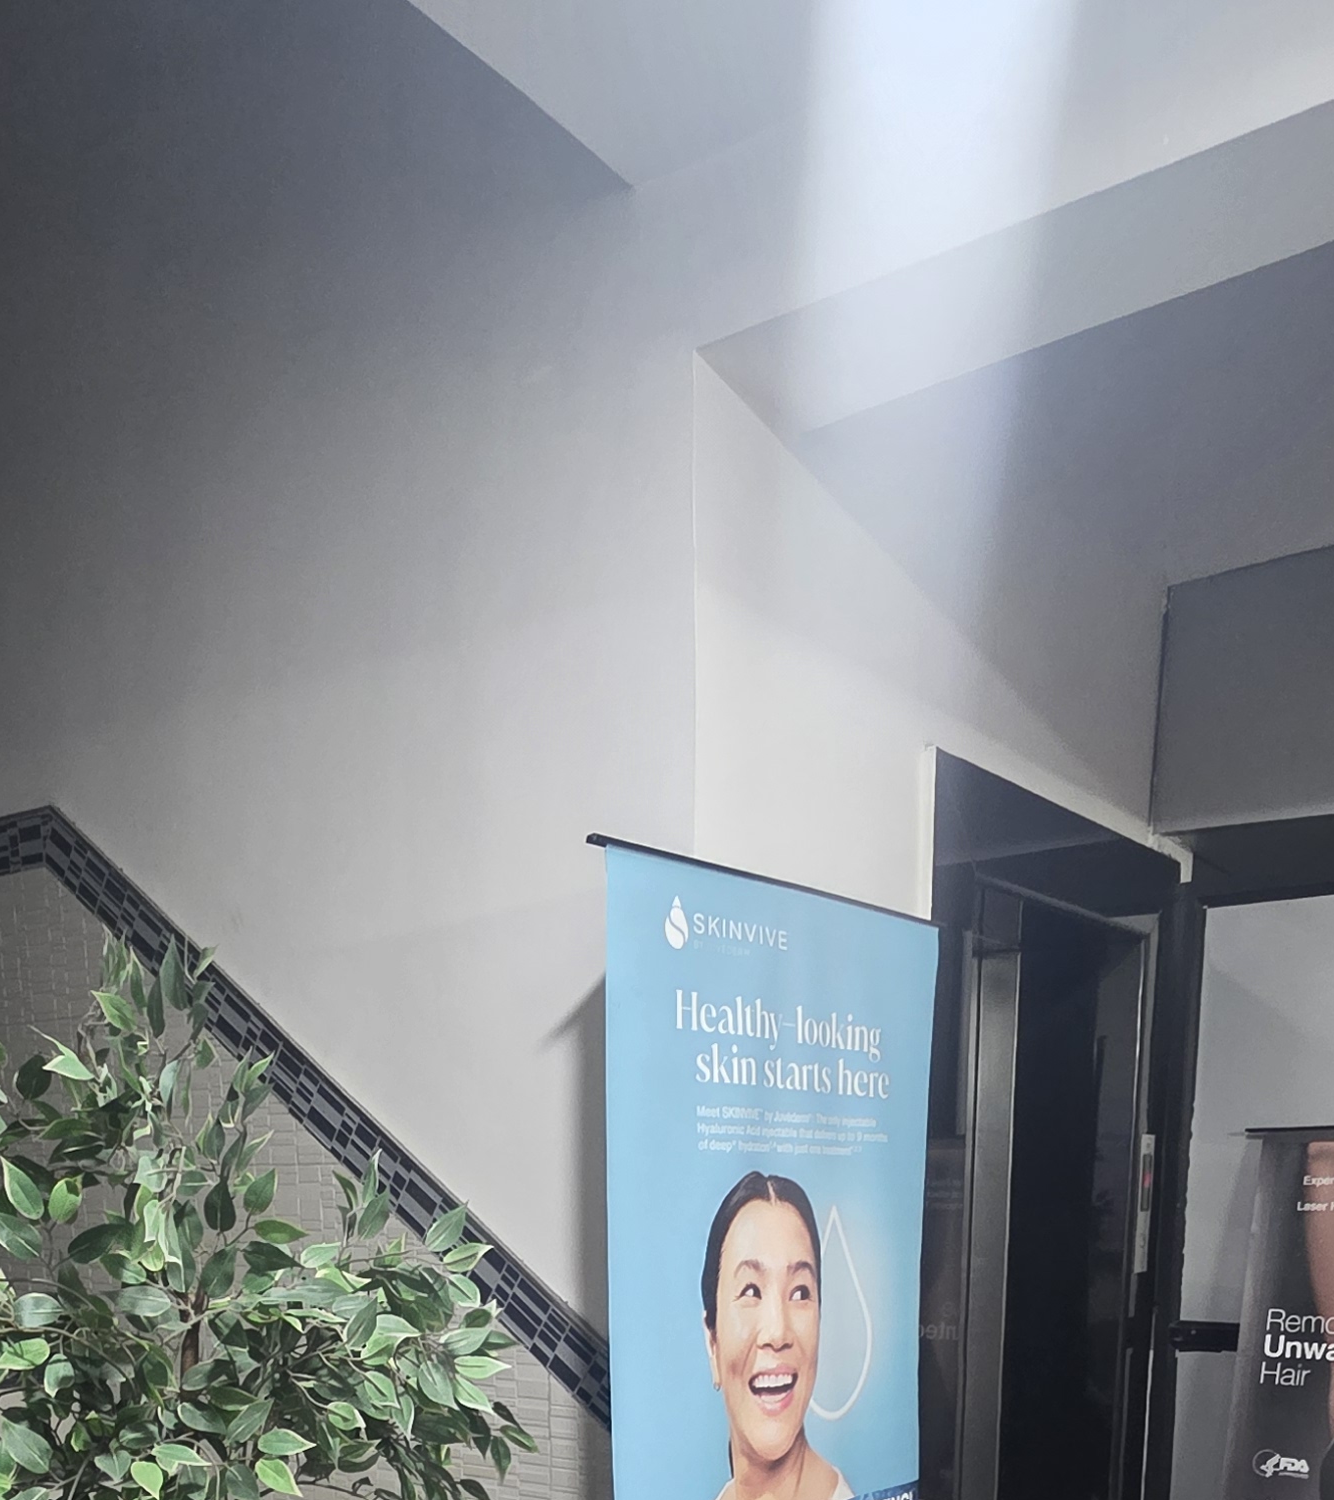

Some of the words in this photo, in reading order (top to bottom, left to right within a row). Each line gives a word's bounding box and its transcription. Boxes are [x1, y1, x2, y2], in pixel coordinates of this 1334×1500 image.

[693, 912, 789, 951] SKINVIVE
[675, 989, 882, 1063] Healthy-looking
[695, 1043, 757, 1086] skin
[763, 1057, 831, 1094] starts
[837, 1058, 889, 1099] here
[697, 1122, 745, 1137] Hyaluronic
[1296, 1201, 1327, 1212] Laser
[1259, 1361, 1312, 1387] Hair
[1279, 1457, 1310, 1473] FDA
